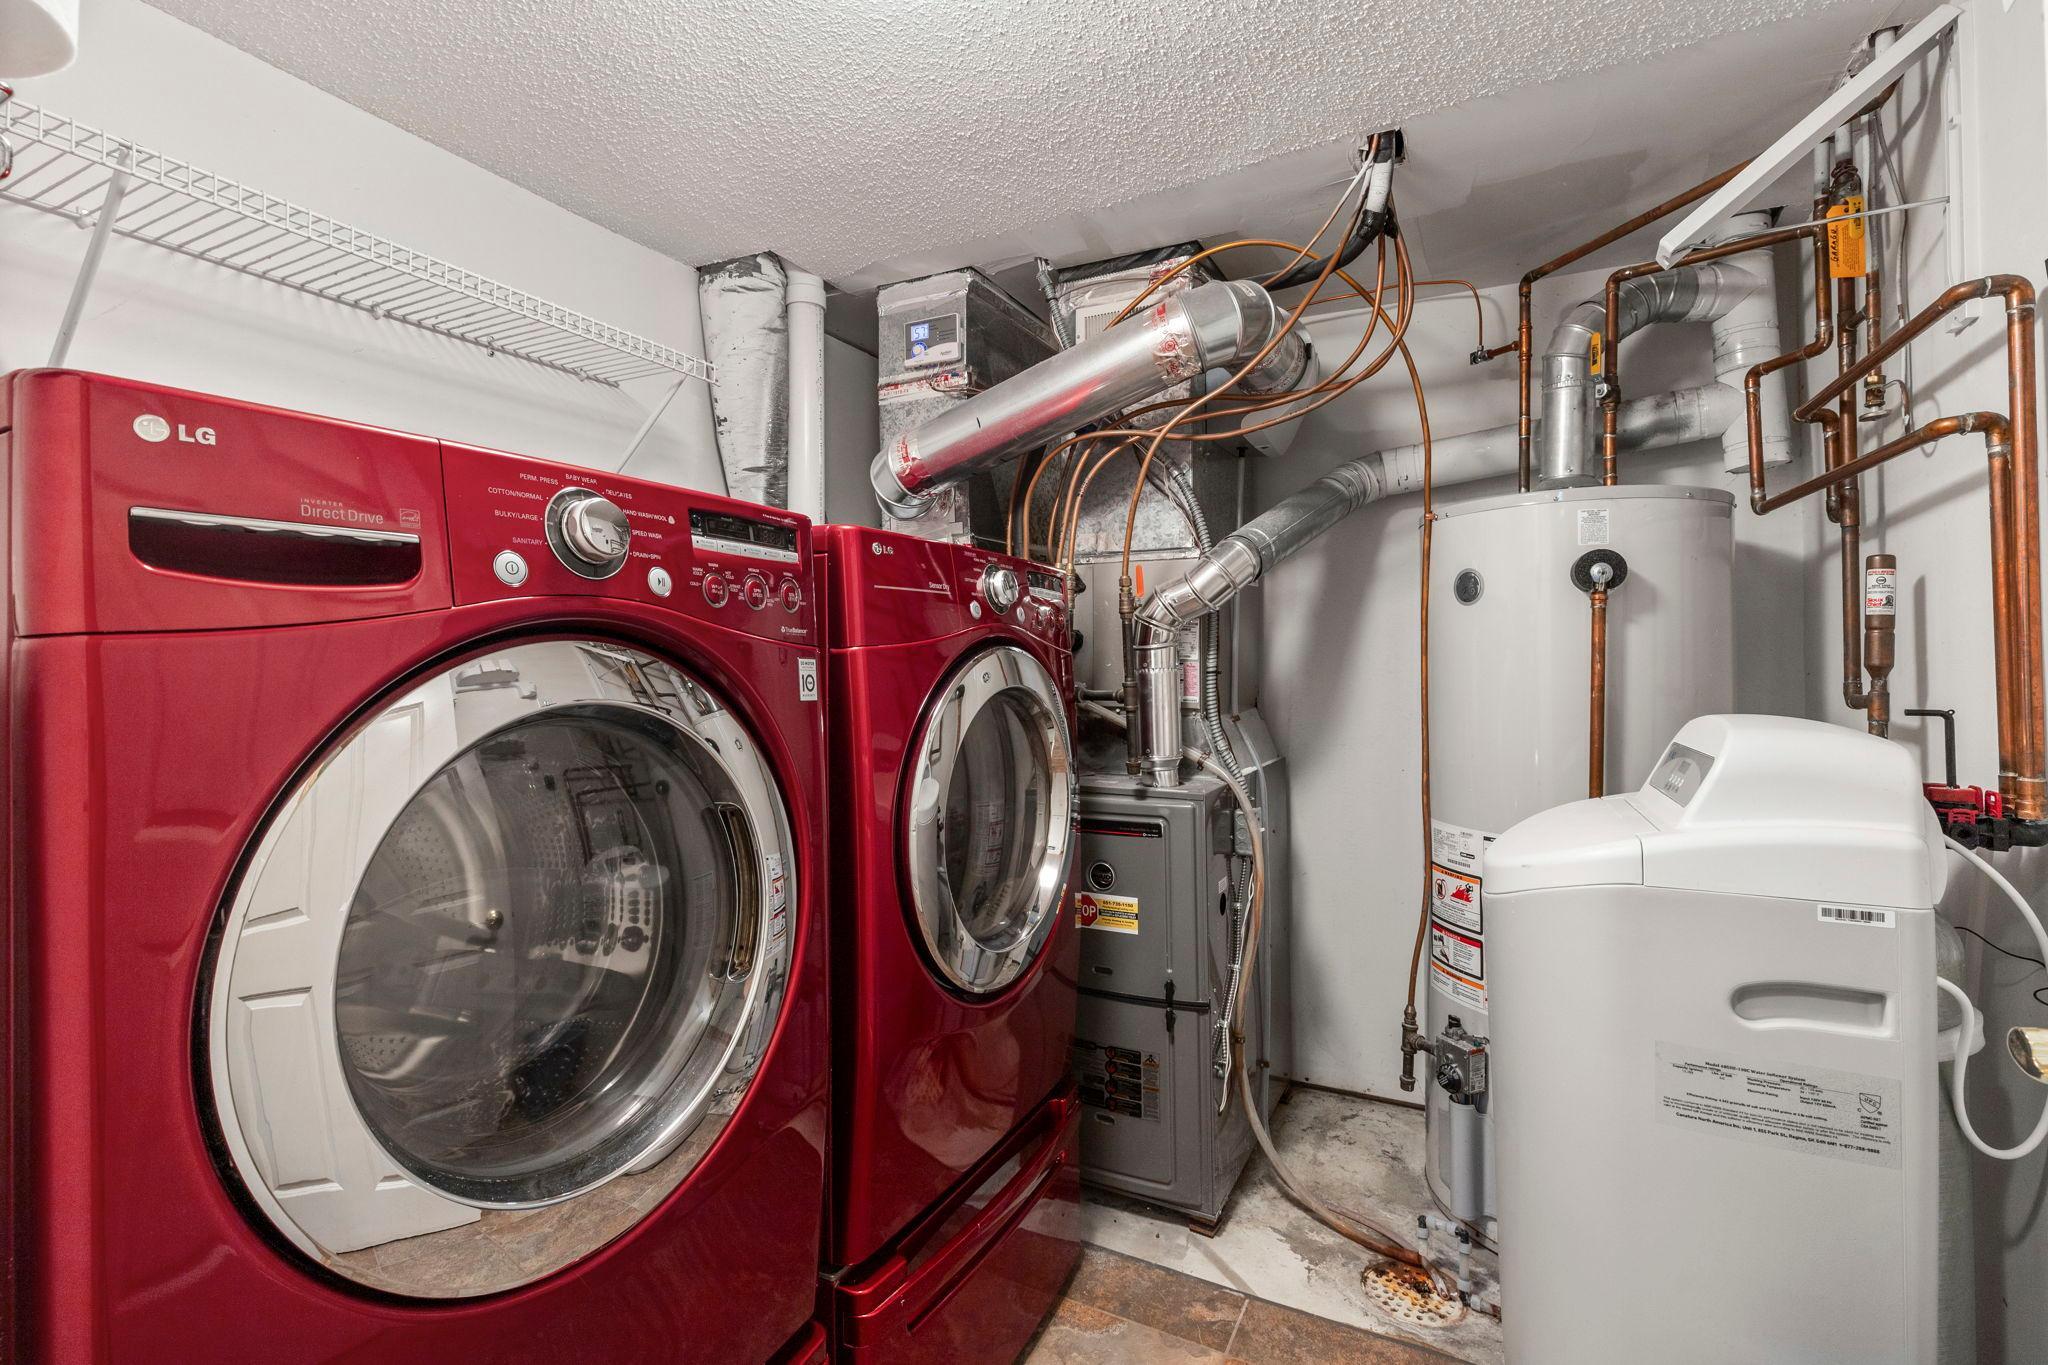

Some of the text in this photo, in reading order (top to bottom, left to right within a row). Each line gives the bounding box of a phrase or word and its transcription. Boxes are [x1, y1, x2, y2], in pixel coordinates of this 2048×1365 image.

[178, 424, 216, 446] LG
[520, 473, 558, 485] PERM. PRESS
[582, 476, 598, 484] WEAR
[488, 486, 544, 500] COTTON/NORMAL
[606, 488, 632, 500] DELICATES
[300, 498, 343, 507] INVERTER
[301, 504, 346, 520] Direct
[348, 510, 384, 525] Drive
[494, 509, 538, 521] BULKY/LARGE
[622, 508, 668, 522] HAND WASH/WOOL
[512, 536, 543, 545] SANITARY
[648, 532, 662, 540] WASH
[883, 545, 894, 554] LG
[928, 582, 950, 592] Sensor Dry
[802, 674, 815, 692] 10
[1082, 905, 1096, 916] OP
